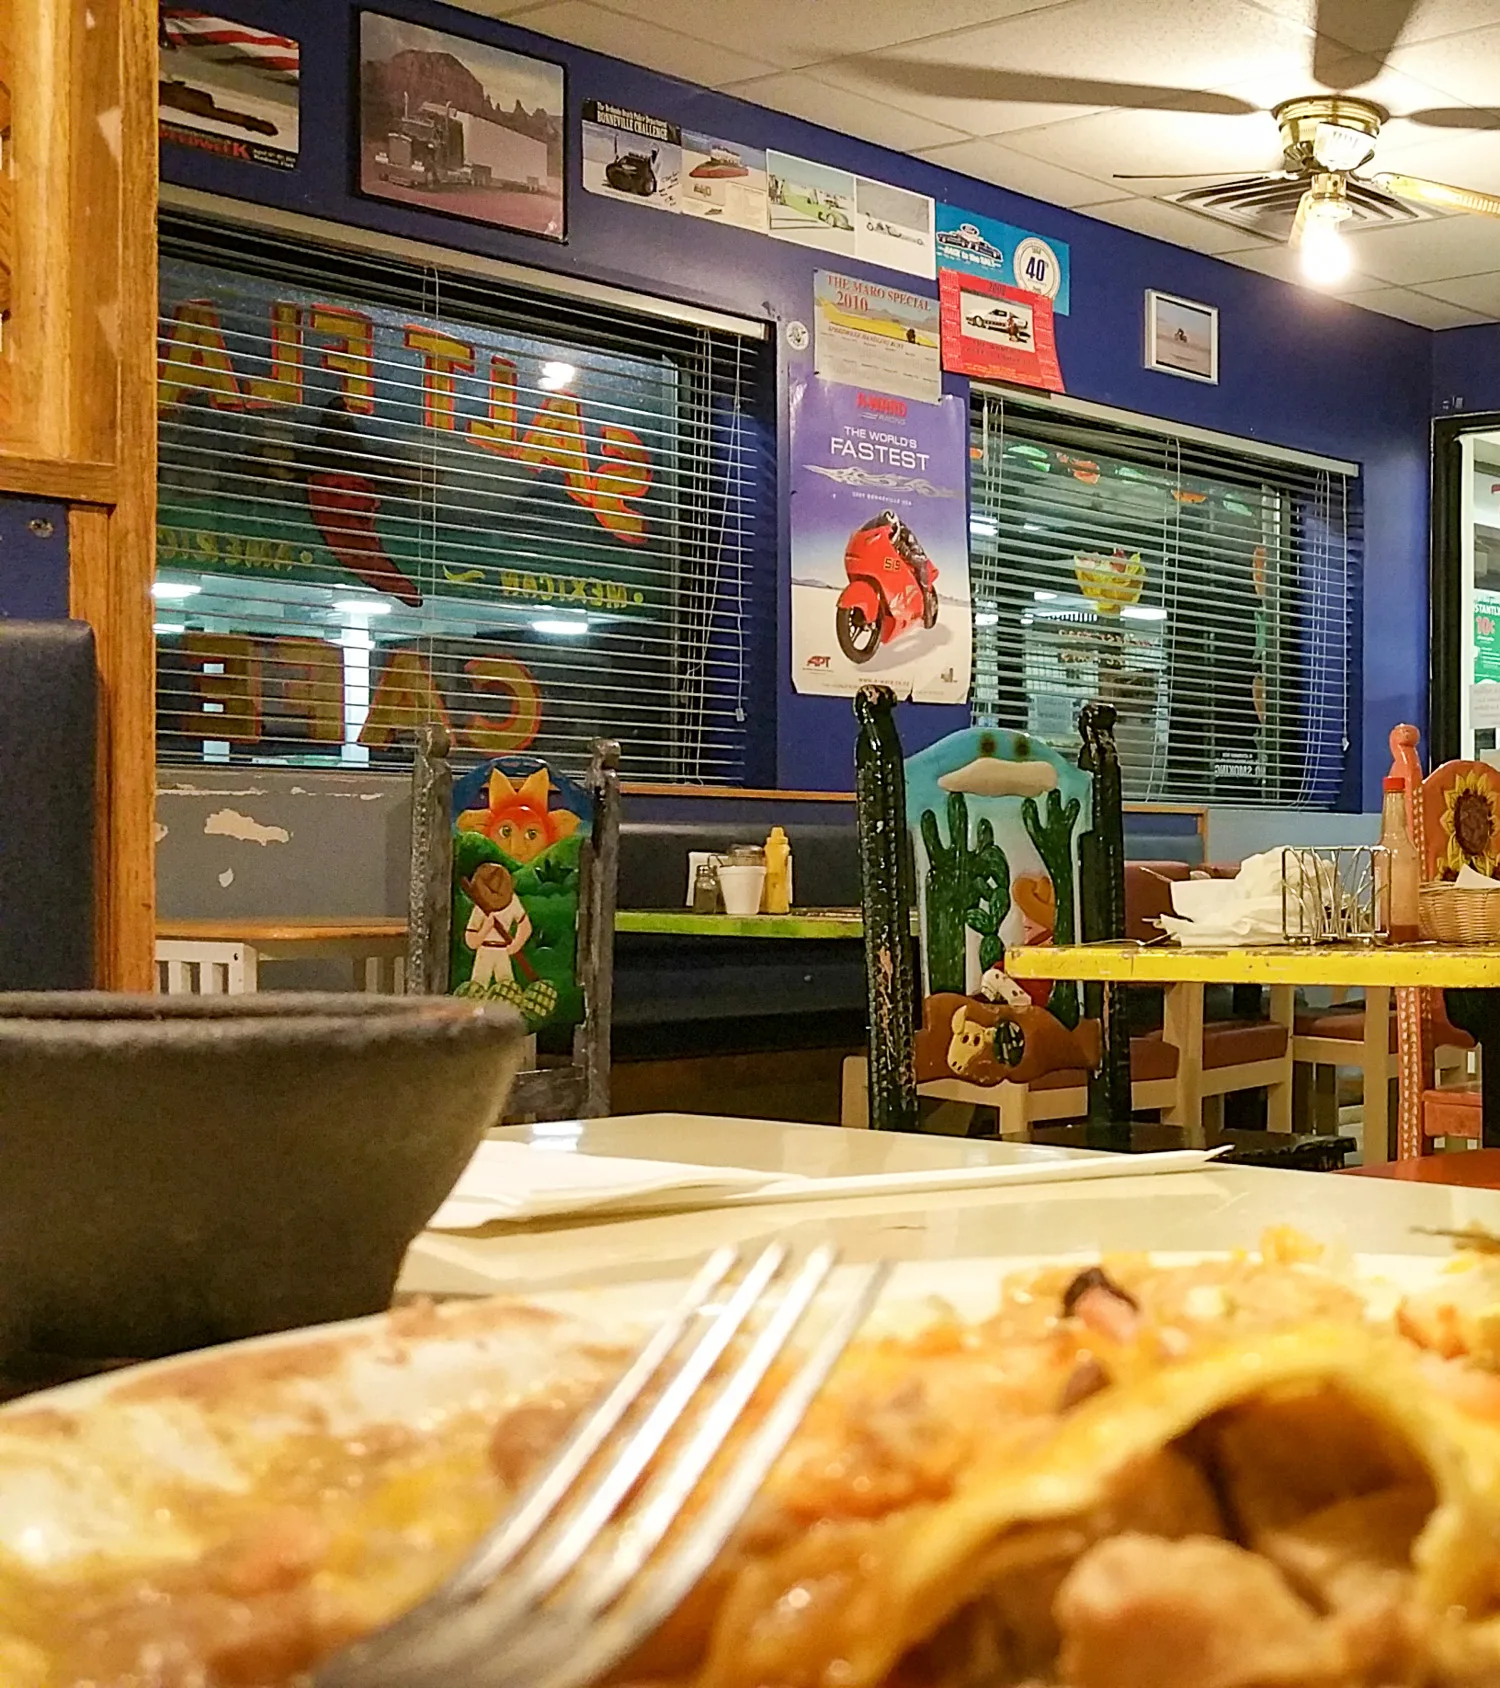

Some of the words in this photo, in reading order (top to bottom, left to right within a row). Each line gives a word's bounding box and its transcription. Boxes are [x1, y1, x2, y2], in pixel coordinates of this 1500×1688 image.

[597, 110, 633, 131] BONNEVILLE
[634, 121, 668, 141] CHALLENGE
[828, 274, 849, 291] THE
[887, 288, 930, 312] SPECIAL
[836, 290, 869, 312] 2010
[844, 425, 867, 439] THE
[868, 430, 918, 449] WORLD'S
[831, 436, 930, 471] FASTEST
